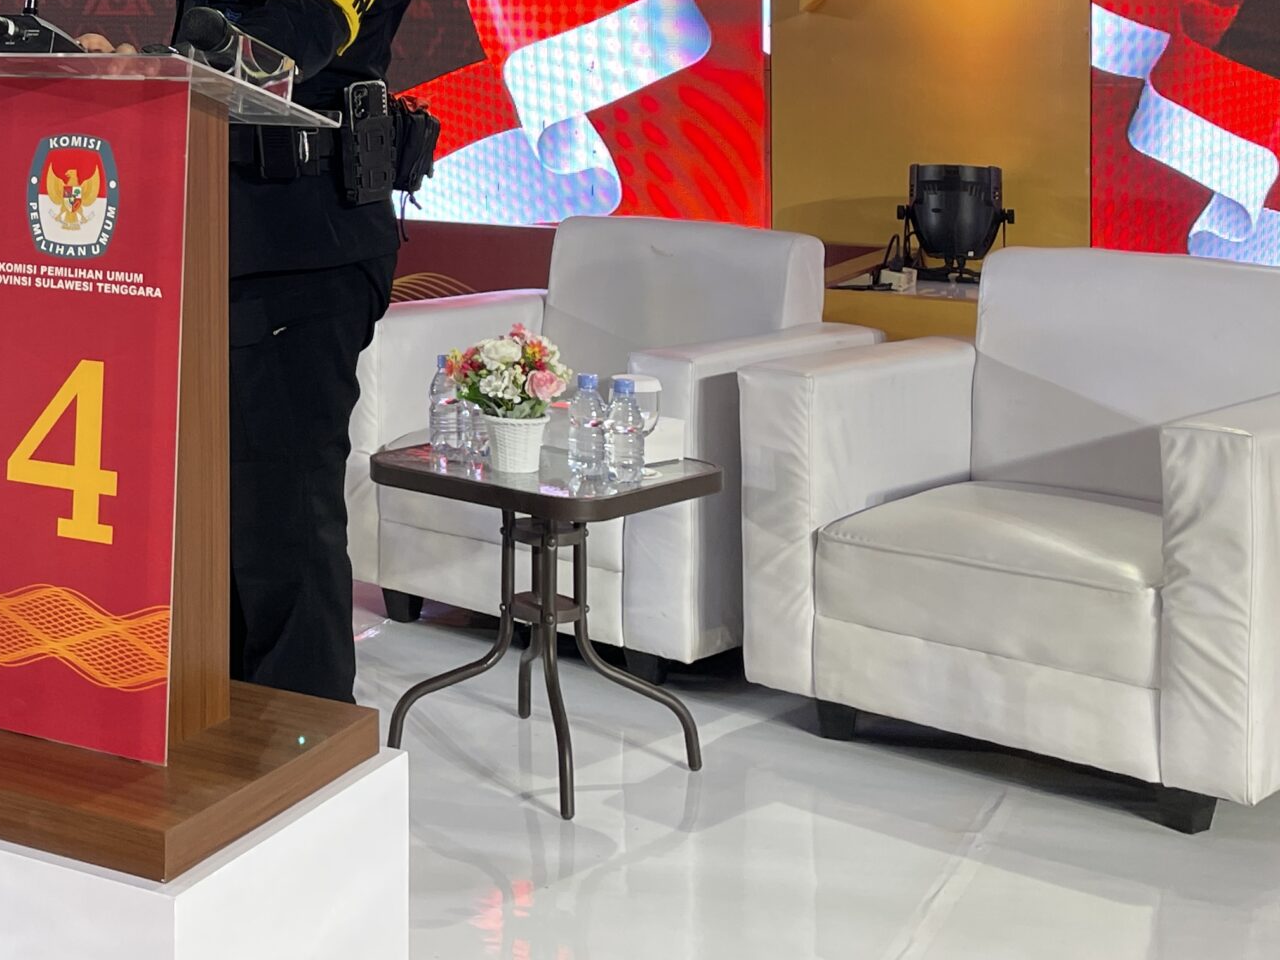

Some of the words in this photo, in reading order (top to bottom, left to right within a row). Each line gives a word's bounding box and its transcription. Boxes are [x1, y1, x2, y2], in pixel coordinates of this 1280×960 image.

[49, 136, 102, 151] KOMISI
[29, 202, 87, 256] PEMILIHAN
[91, 206, 117, 255] UMUM
[40, 265, 103, 280] PEMILIHAN
[106, 271, 144, 283] UMUM
[35, 277, 93, 292] SULAWESI
[96, 282, 162, 298] TENGGARA
[7, 359, 118, 545] 4
